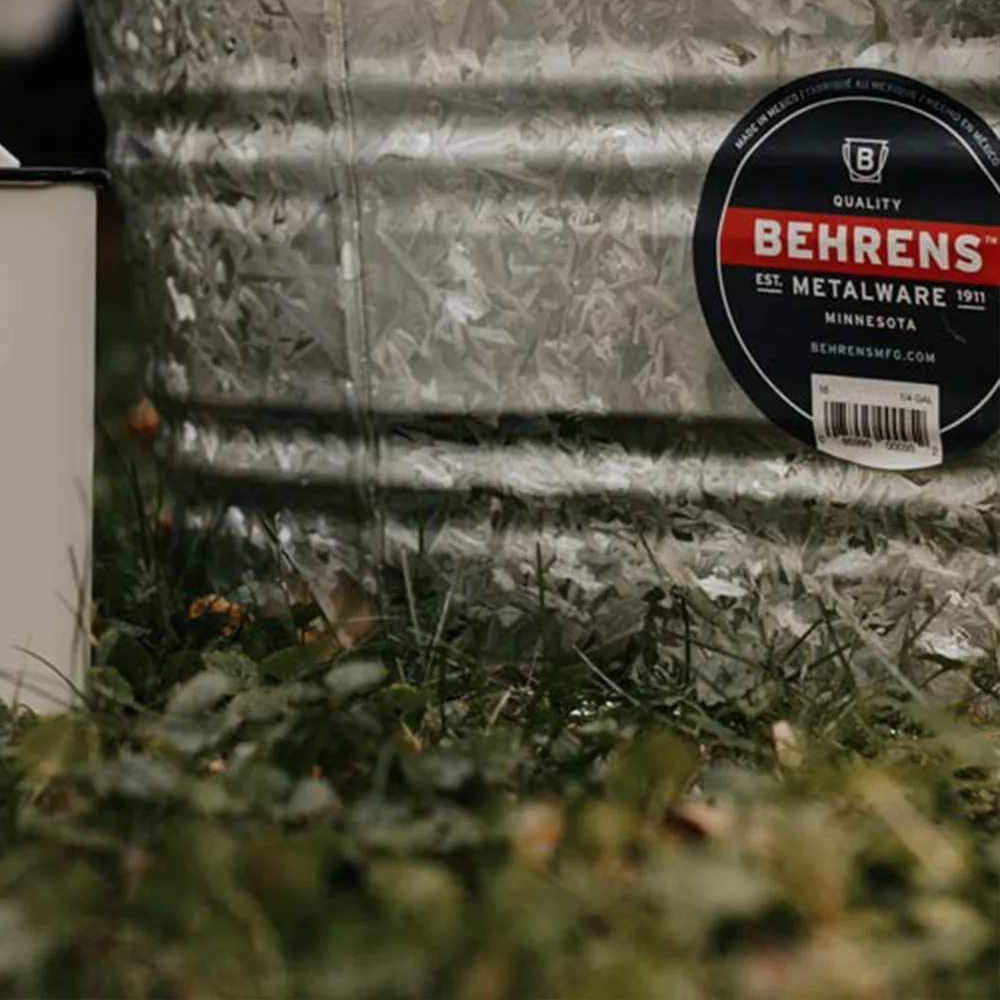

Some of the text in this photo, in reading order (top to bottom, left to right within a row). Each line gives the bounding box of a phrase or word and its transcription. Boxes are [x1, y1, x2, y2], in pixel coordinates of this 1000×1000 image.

[735, 122, 759, 149] MADE
[756, 113, 769, 128] IN
[766, 93, 799, 118] MEXICO
[855, 147, 875, 171] B
[833, 194, 902, 211] QUALITY
[753, 217, 984, 273] BEHRENS
[755, 272, 986, 308] EST. METALWARE 1911
[825, 311, 917, 331] MINNESOTA
[810, 341, 936, 364] BEHRENSMFG.COM
